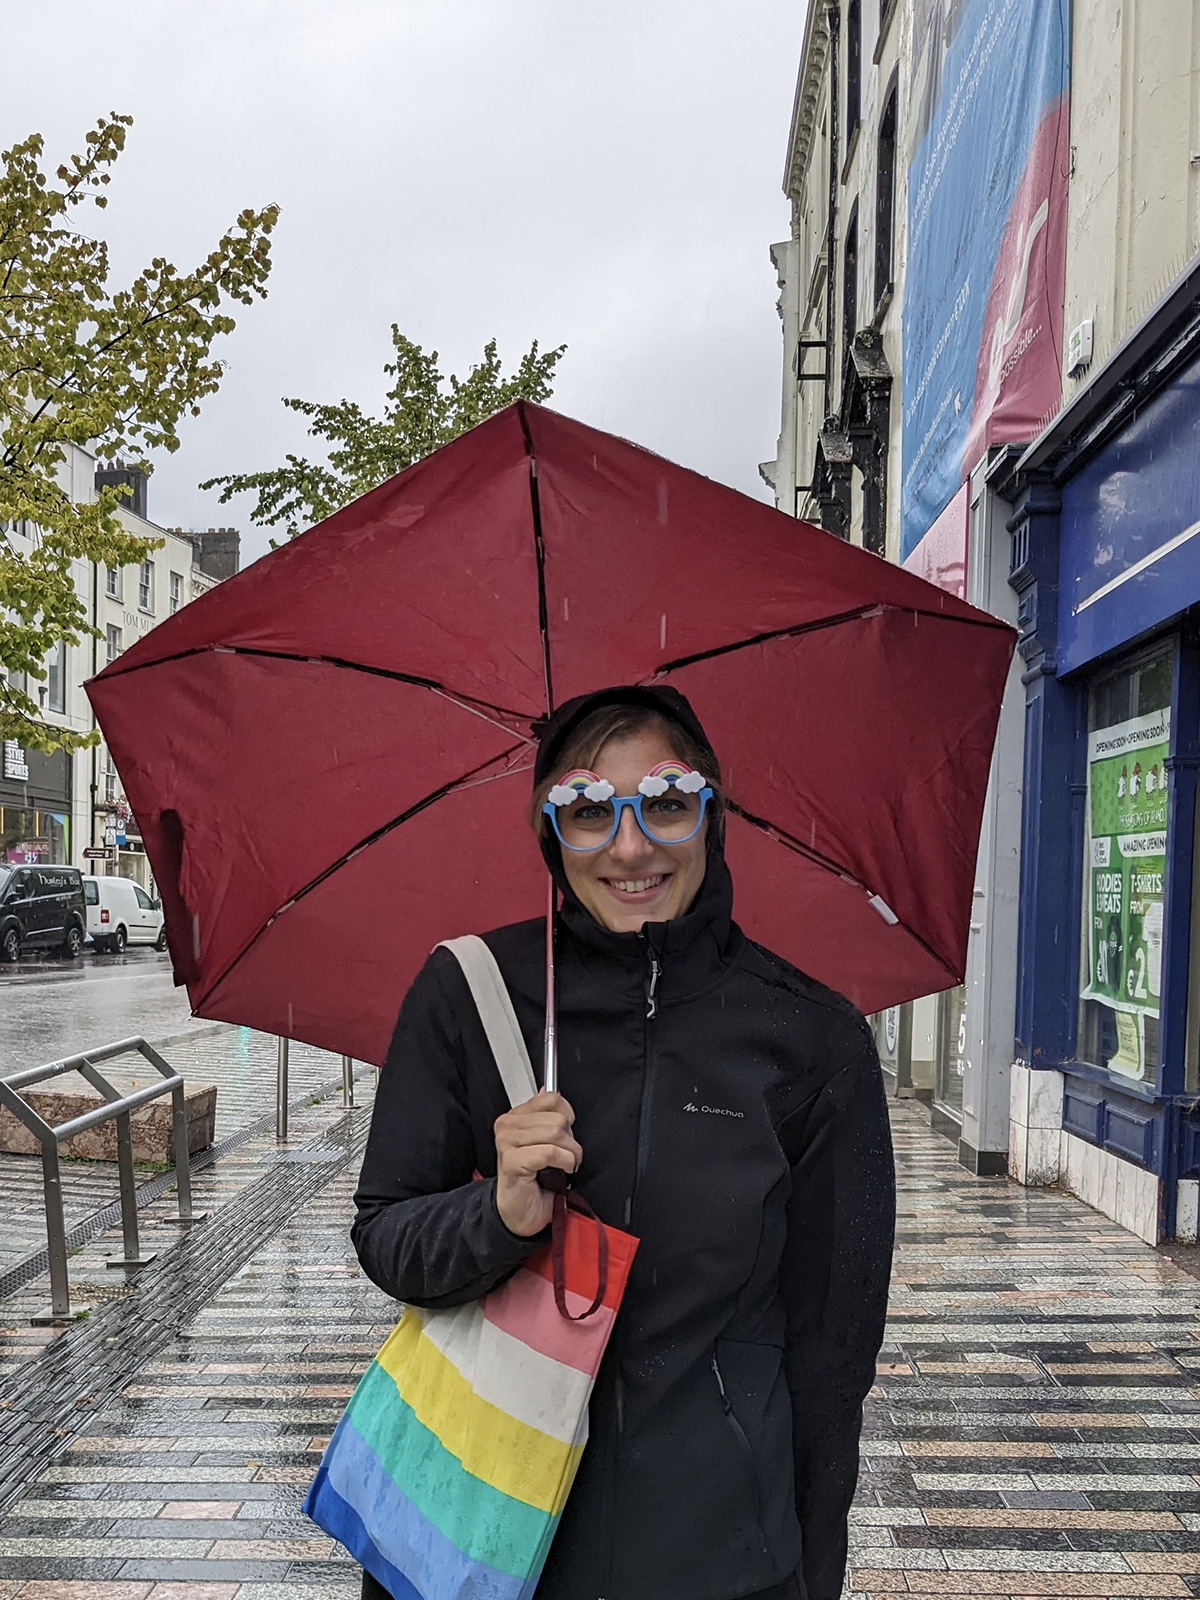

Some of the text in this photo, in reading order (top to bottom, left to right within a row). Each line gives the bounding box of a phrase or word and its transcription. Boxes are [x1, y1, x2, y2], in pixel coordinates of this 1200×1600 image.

[122, 610, 138, 628] TOM
[5, 747, 25, 761] STYLE
[4, 763, 29, 777] SPORTS
[1122, 839, 1146, 852] AMAZING
[1096, 873, 1162, 894] HOODIES T-SHIRTS
[1130, 901, 1144, 915] FROM
[701, 1105, 744, 1118] Quechua
